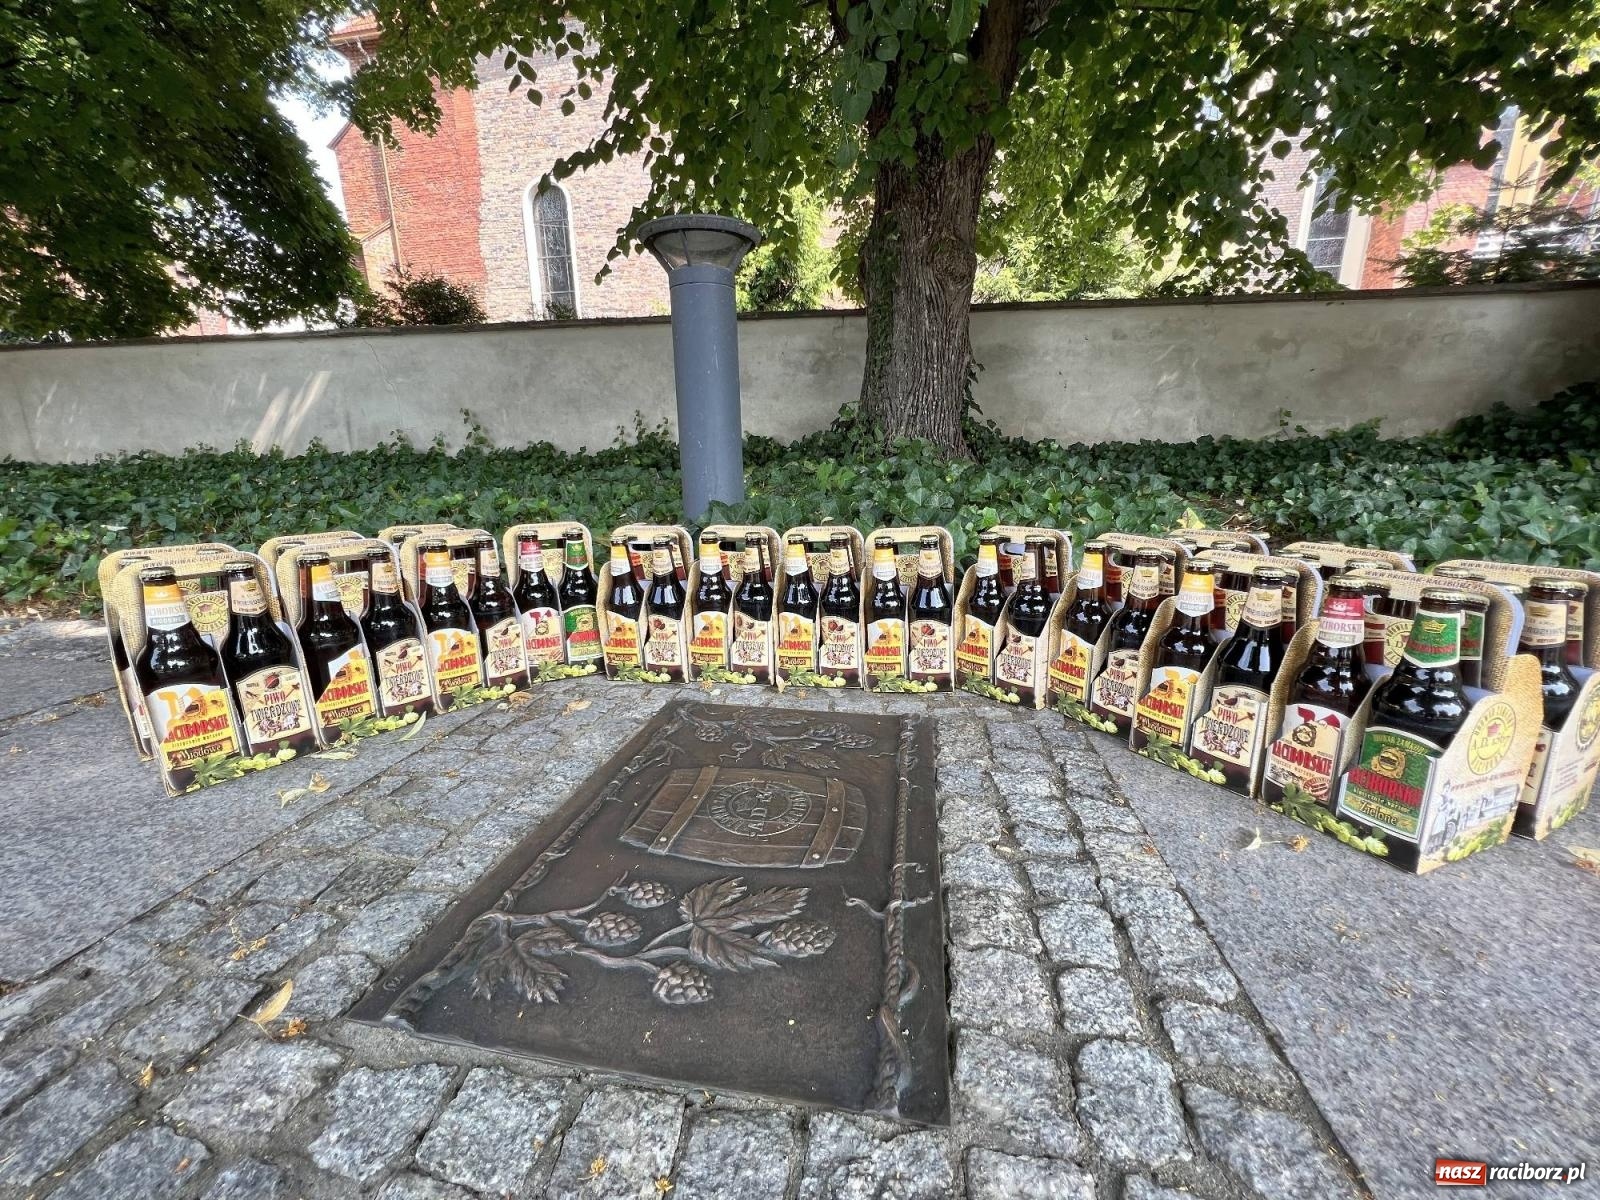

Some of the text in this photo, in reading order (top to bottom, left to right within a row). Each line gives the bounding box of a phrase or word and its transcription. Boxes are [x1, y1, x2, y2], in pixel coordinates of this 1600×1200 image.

[1460, 562, 1588, 578] WWW.BROWAR-RACIBORZ.PL
[1365, 570, 1484, 592] WWW.BROWAR-RACIBORZ.PL
[263, 691, 286, 706] PIWO
[250, 698, 302, 722] TWIERDZOWE
[1217, 707, 1238, 725] PIWO
[1201, 716, 1251, 743] TWIERDZOWE
[180, 743, 222, 760] Miodowe
[1359, 799, 1399, 826] Zielone
